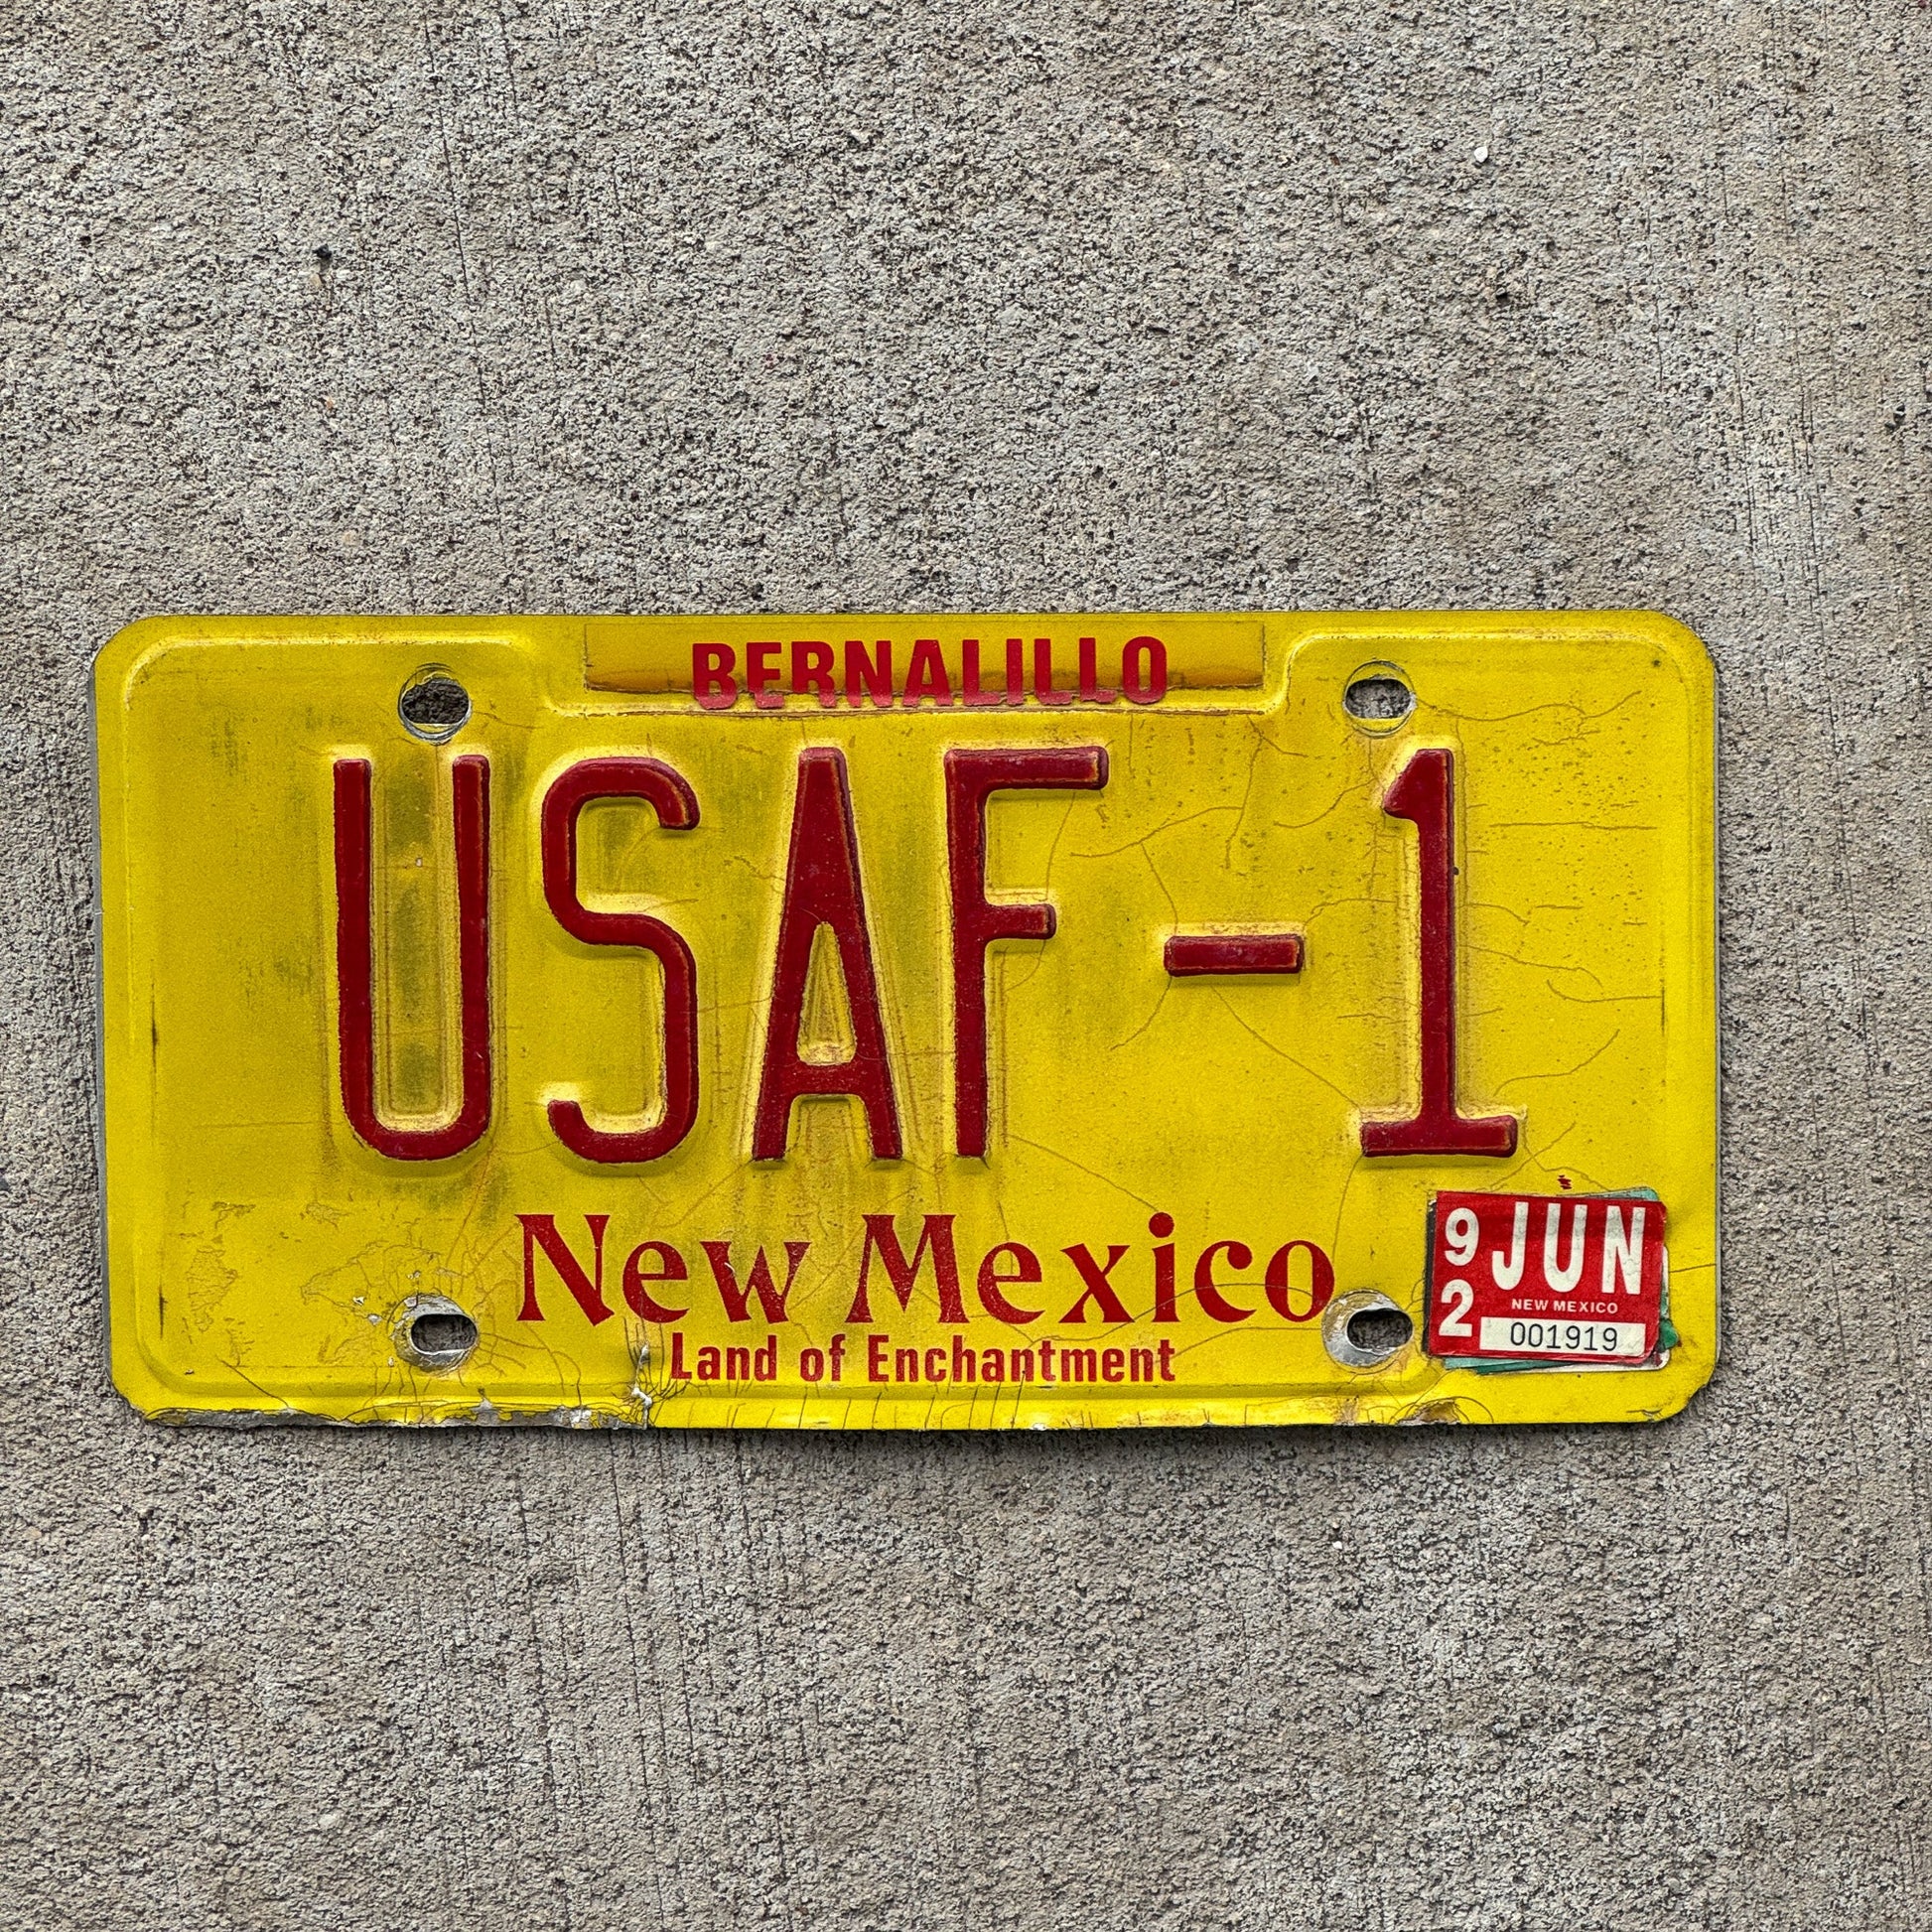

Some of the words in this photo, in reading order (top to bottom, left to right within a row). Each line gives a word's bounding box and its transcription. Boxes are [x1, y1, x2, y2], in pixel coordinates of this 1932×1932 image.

[692, 636, 1167, 710] BERNALILLO
[334, 747, 1516, 1164] USAF-1
[517, 1214, 809, 1324] New
[846, 1212, 1335, 1324] Mexico
[1491, 1201, 1646, 1296] JUN
[1510, 1321, 1618, 1352] 001919
[1511, 1298, 1549, 1311] NEW
[1553, 1300, 1618, 1314] MEXICO
[671, 1332, 777, 1381] Land
[799, 1333, 846, 1381] of
[868, 1334, 1174, 1383] Enchantment
